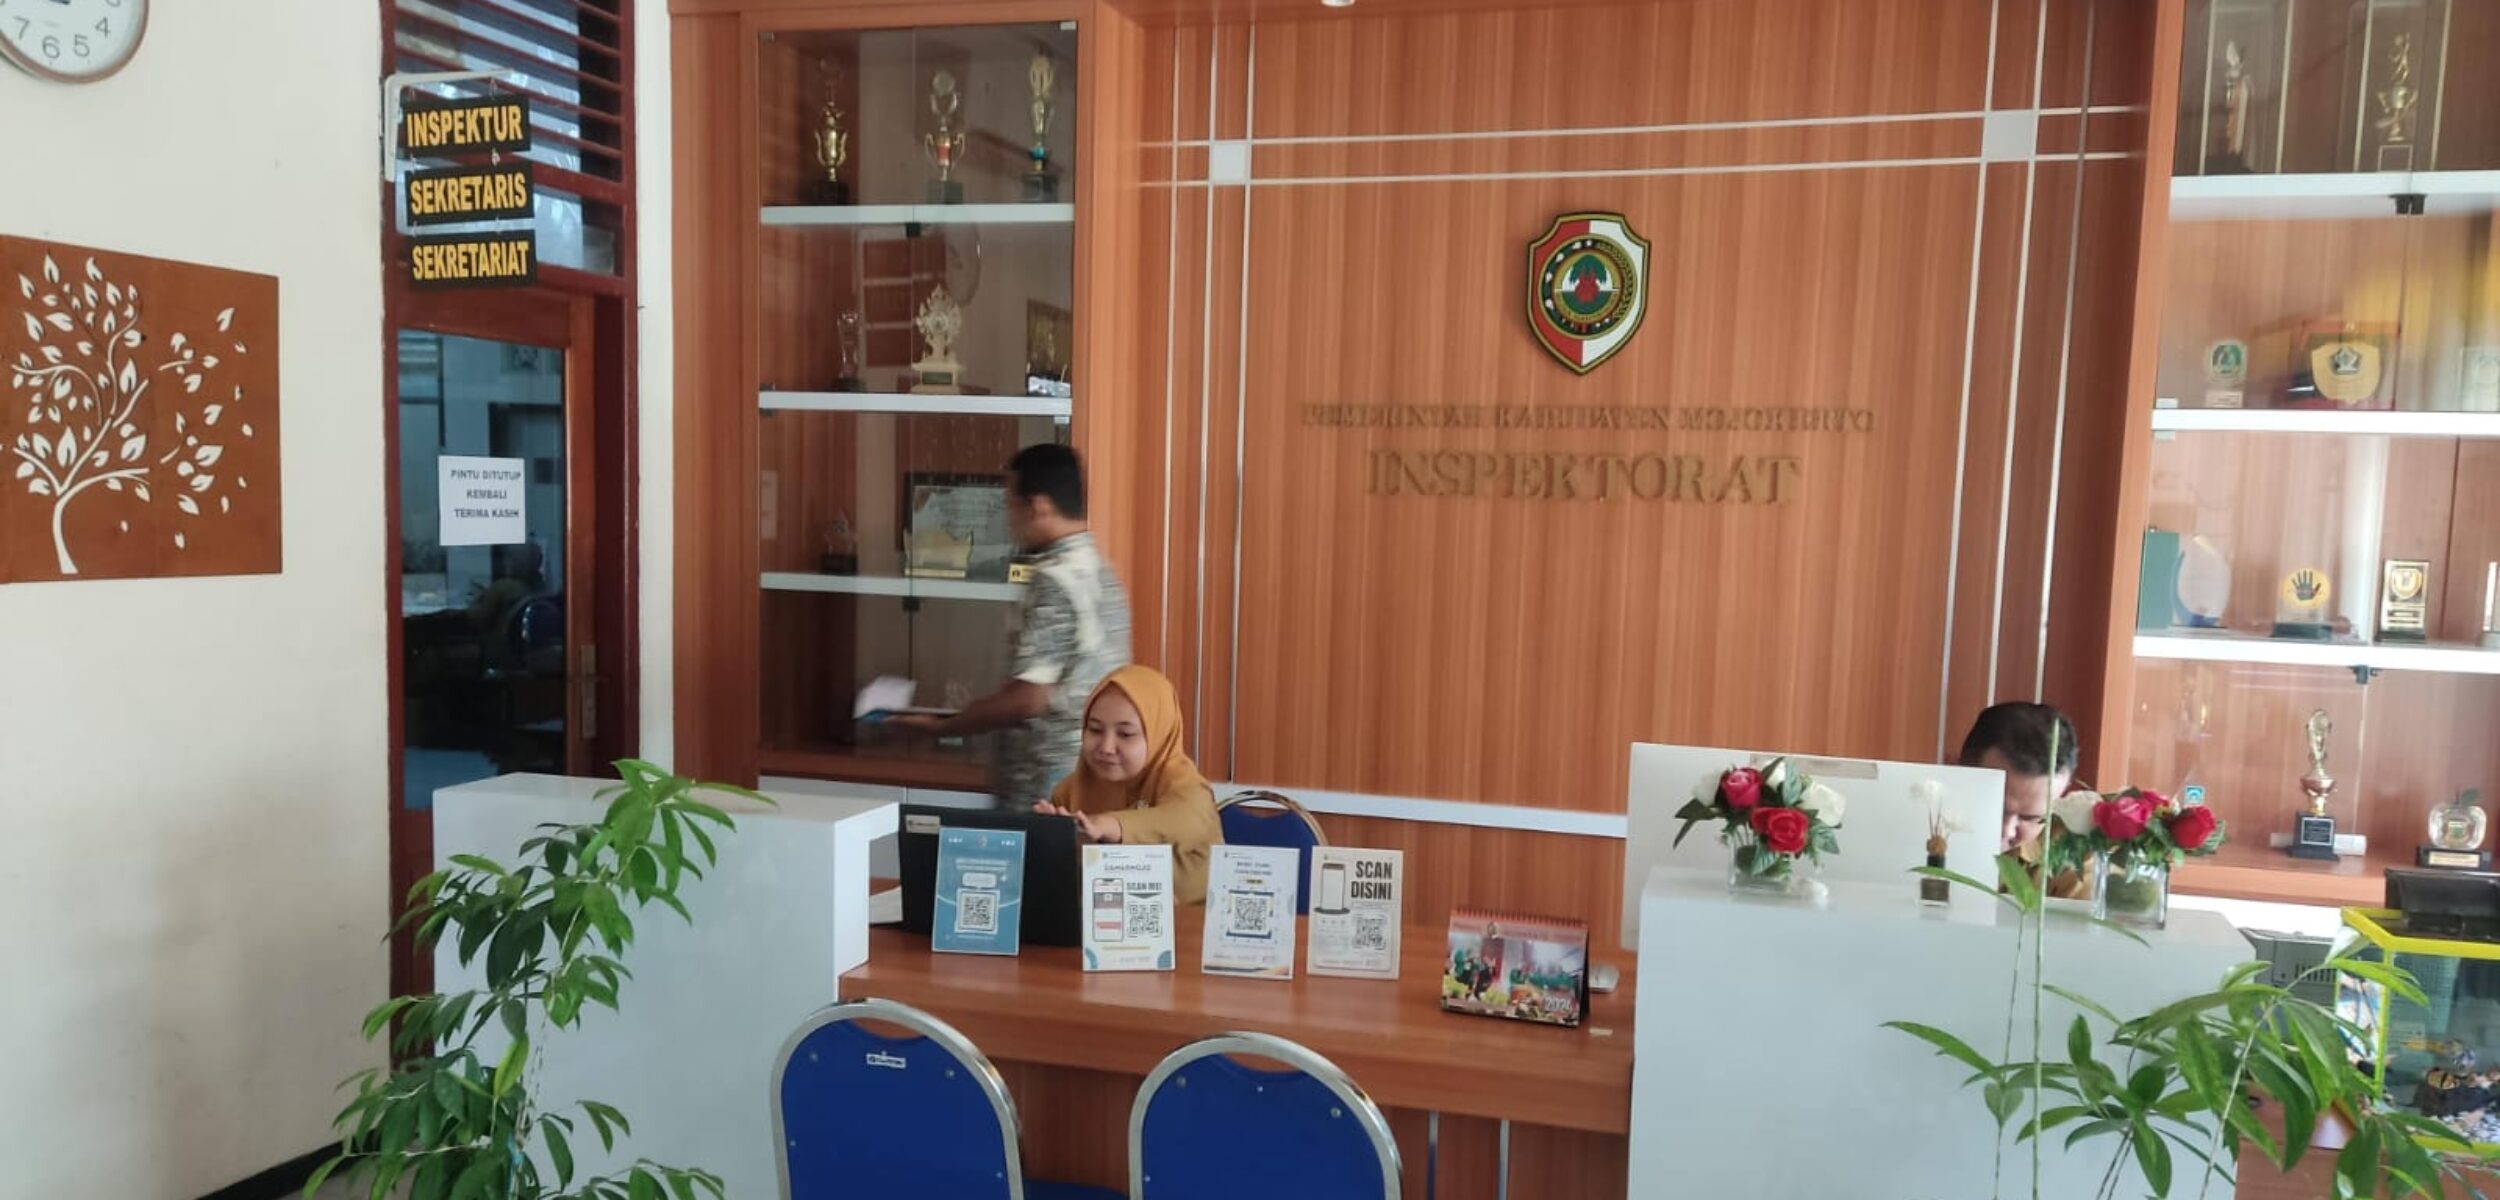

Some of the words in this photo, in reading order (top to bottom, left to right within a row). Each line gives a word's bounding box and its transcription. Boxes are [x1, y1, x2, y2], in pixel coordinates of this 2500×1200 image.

[13, 15, 30, 40] 7
[94, 16, 111, 39] 4
[41, 34, 60, 59] 6
[73, 33, 90, 58] 5
[407, 105, 523, 147] INSPEKTUR
[410, 172, 527, 215] SEKRETARIS
[412, 241, 529, 280] SEKRETARIAT
[1679, 406, 1875, 433] MOJOKERTO
[450, 469, 480, 481] PINTU
[1366, 448, 1801, 504] INSPEKTORAT
[466, 489, 507, 500] KEMBALI
[454, 508, 490, 518] TERIMA
[1355, 860, 1393, 880] SCAN
[1351, 880, 1393, 901] DISINI
